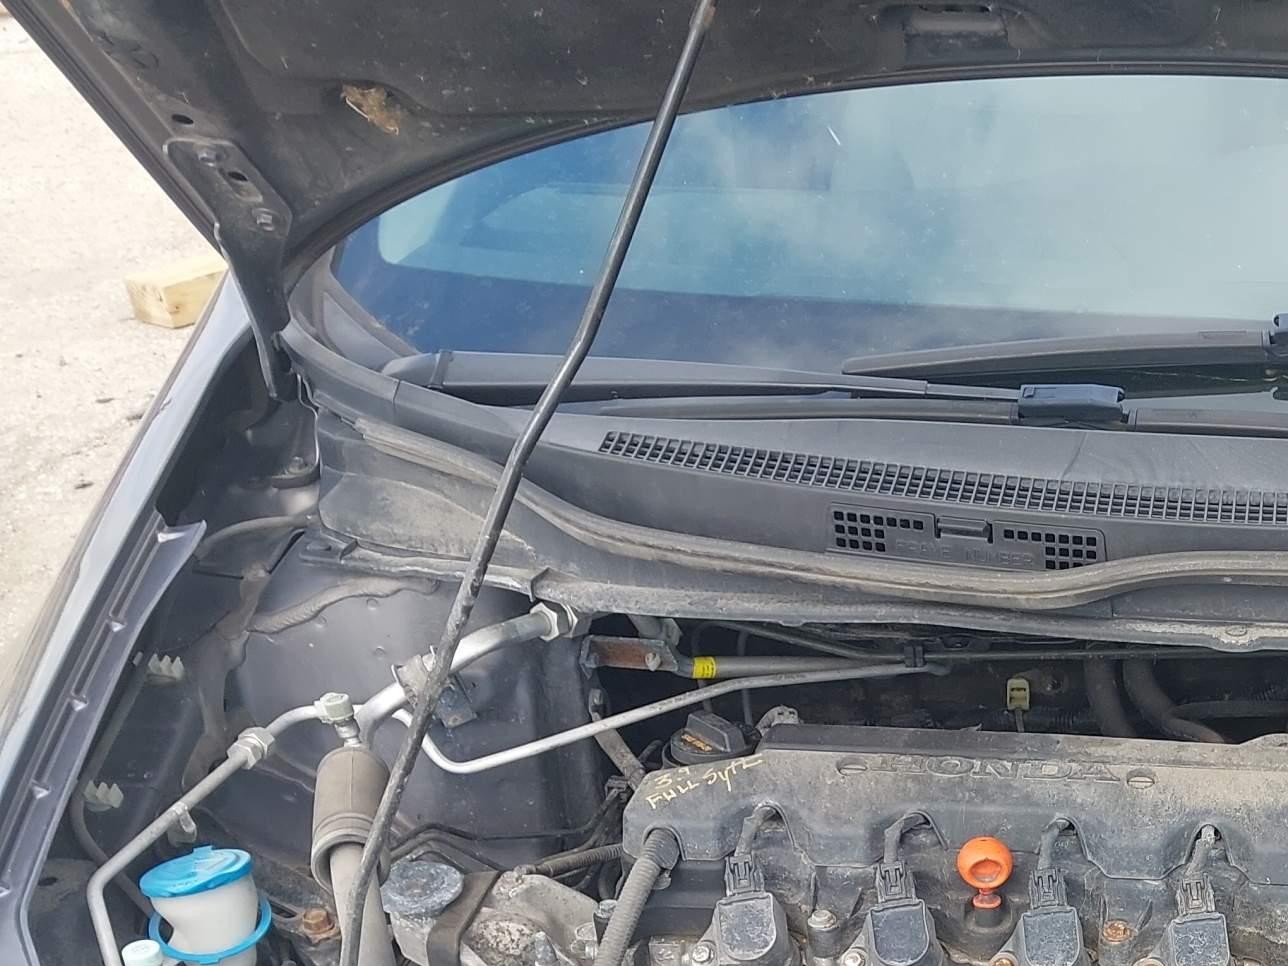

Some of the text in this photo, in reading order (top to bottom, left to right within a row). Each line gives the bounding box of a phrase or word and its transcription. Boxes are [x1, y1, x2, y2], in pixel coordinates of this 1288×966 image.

[965, 546, 1034, 566] NUMBER
[869, 755, 1121, 783] HONDA
[645, 780, 700, 809] FULL
